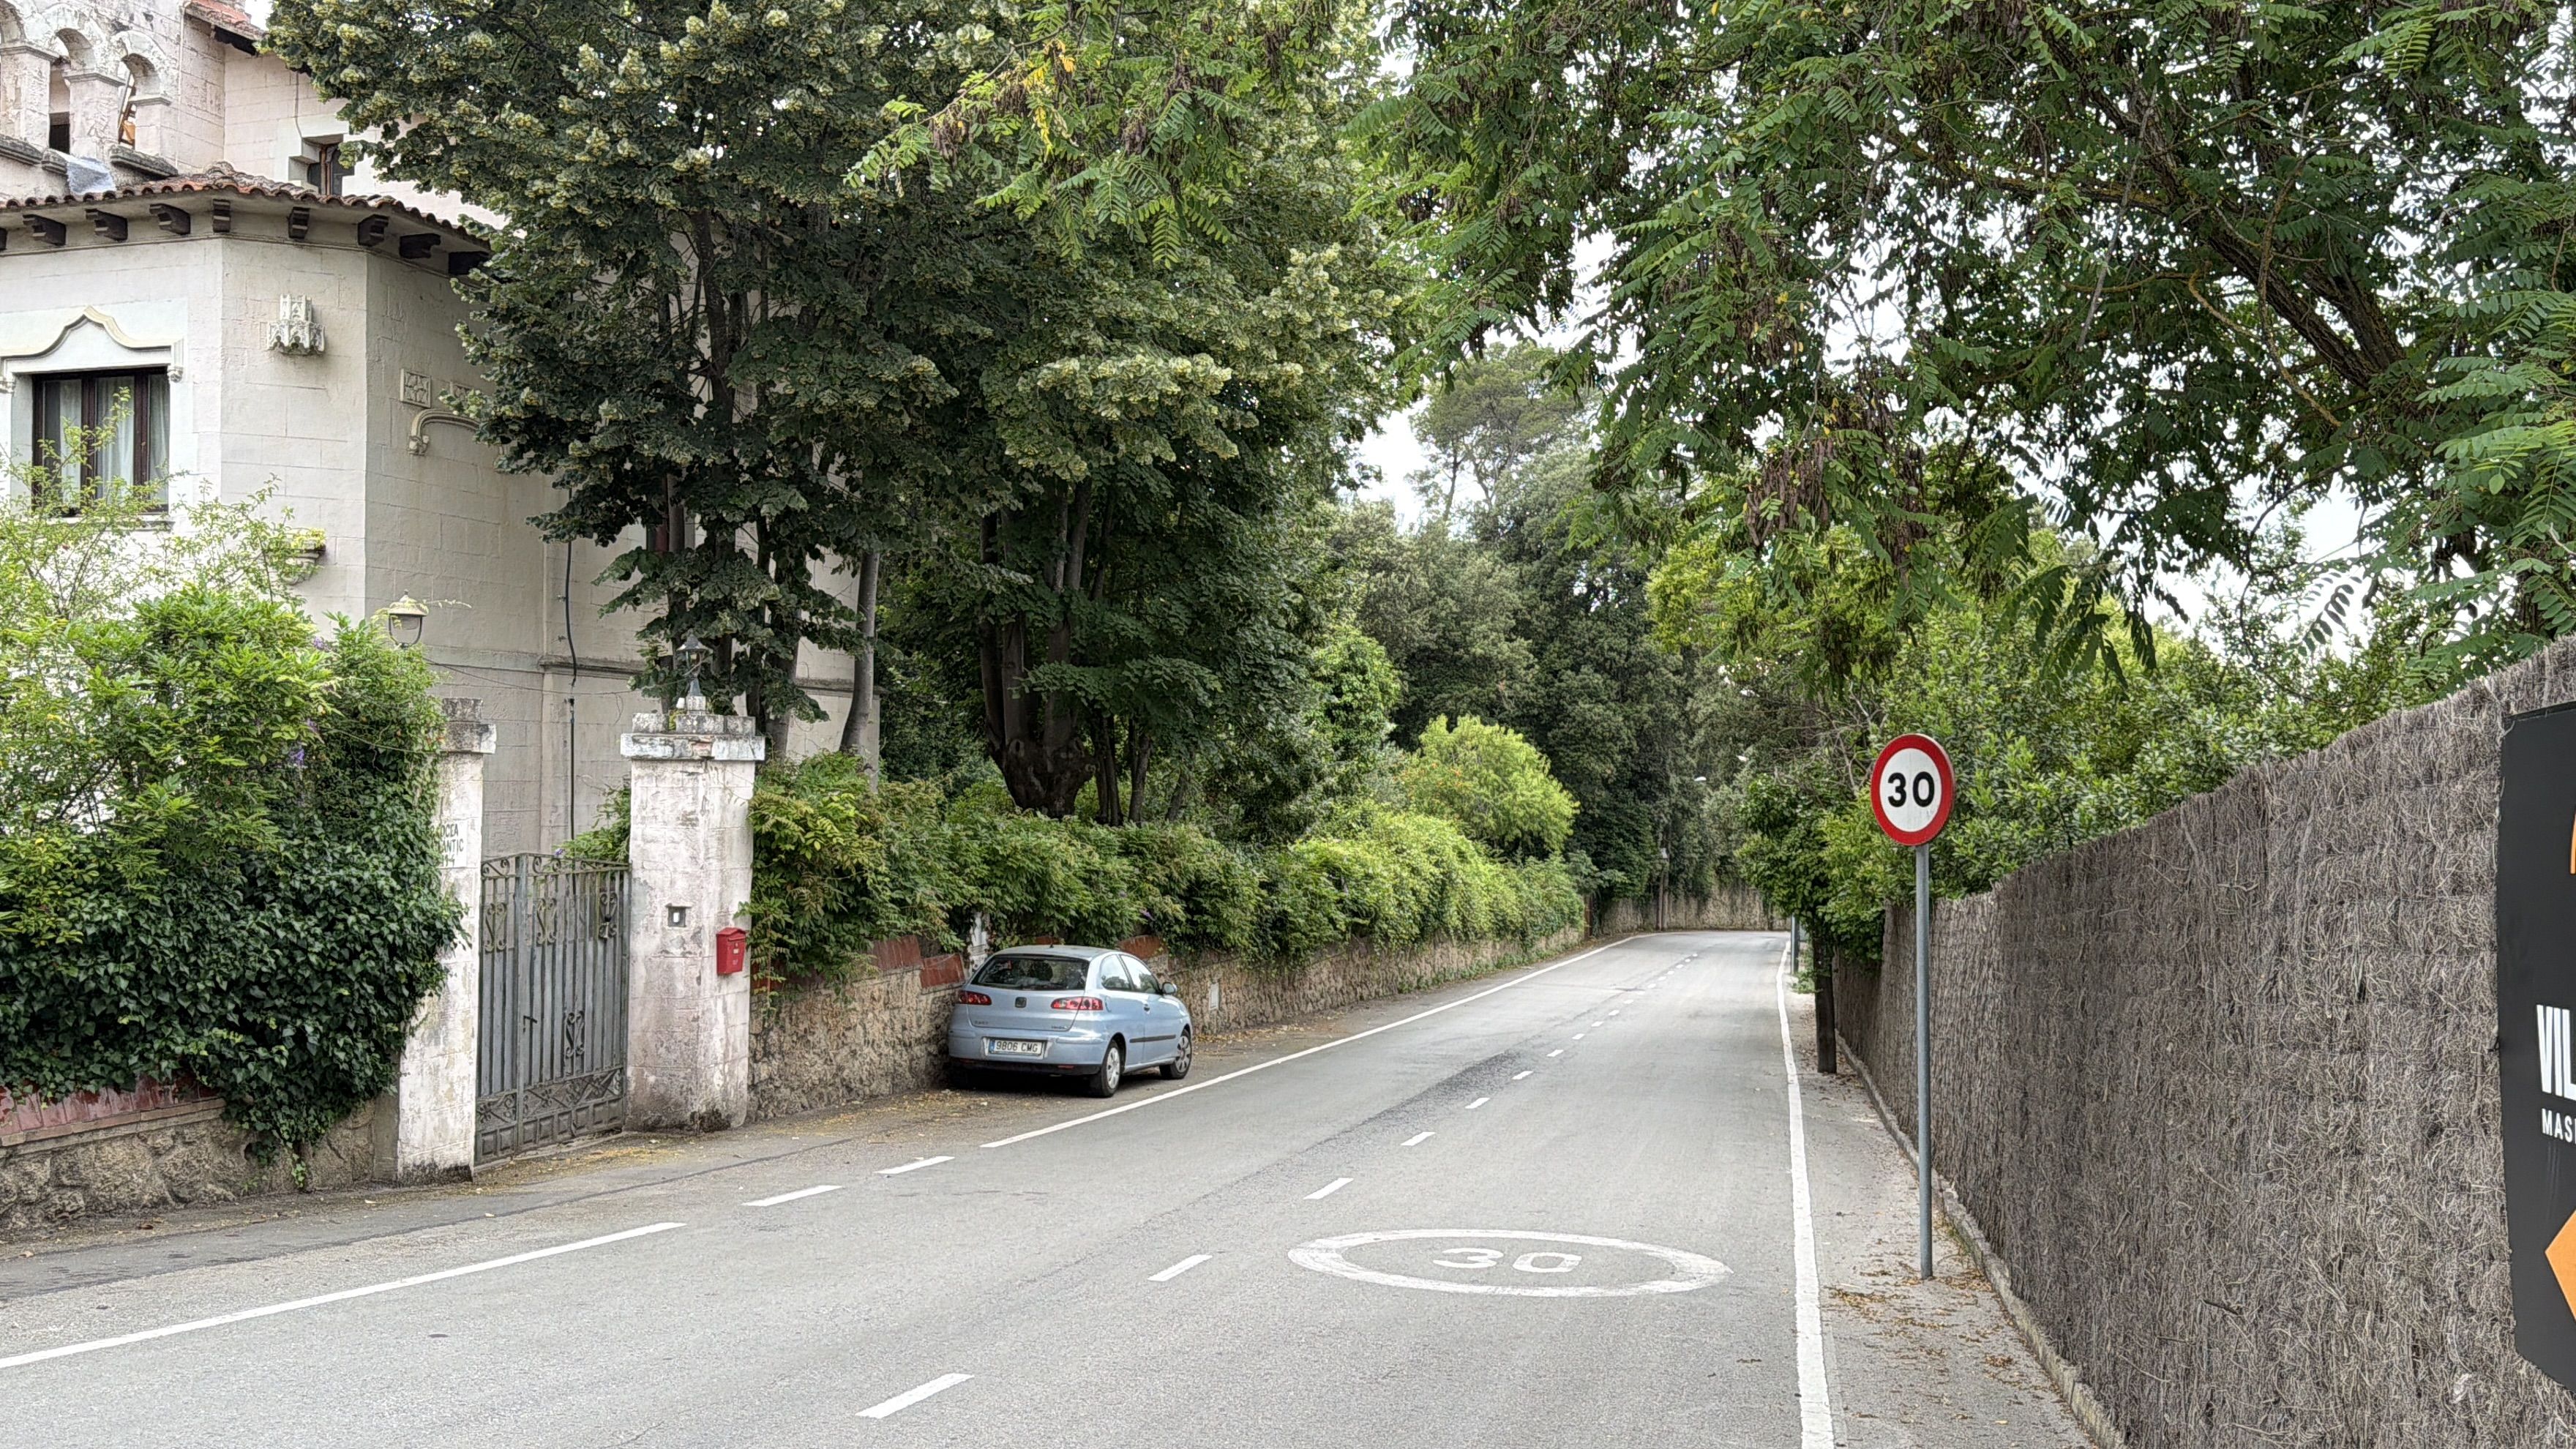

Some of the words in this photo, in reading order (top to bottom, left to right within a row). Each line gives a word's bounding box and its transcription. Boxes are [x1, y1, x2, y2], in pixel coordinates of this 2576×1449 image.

[1887, 771, 1935, 808] 30
[996, 1041, 1018, 1052] 9806
[2542, 1108, 2576, 1145] MAS
[1432, 1247, 1582, 1273] 30
